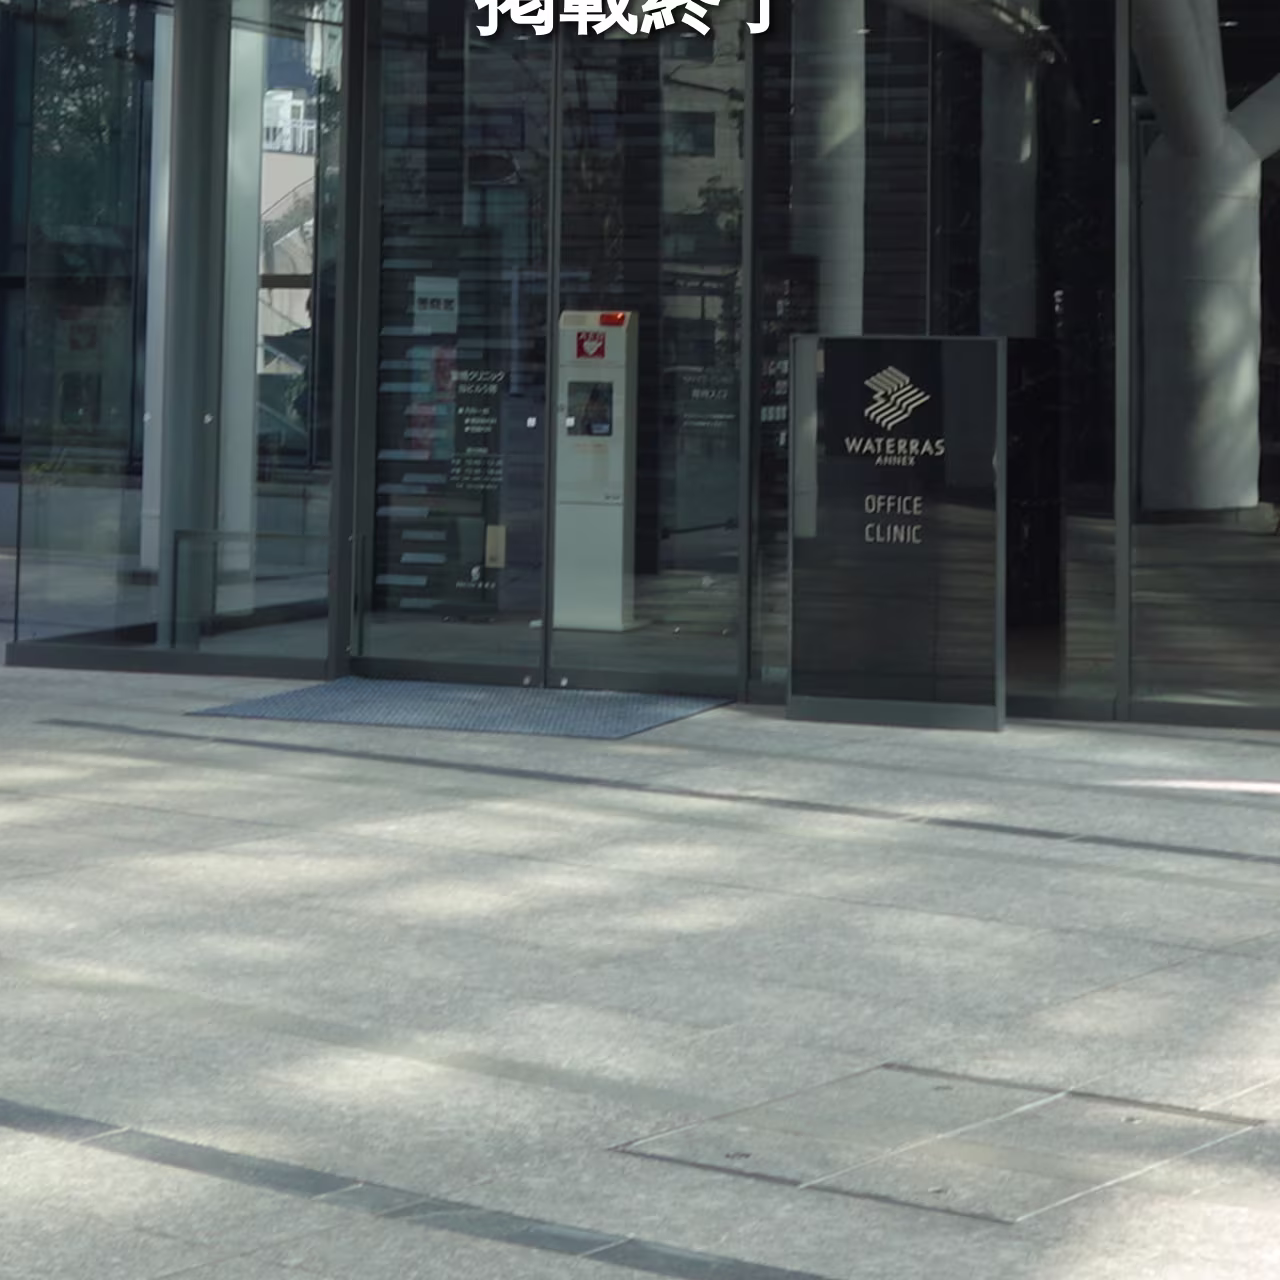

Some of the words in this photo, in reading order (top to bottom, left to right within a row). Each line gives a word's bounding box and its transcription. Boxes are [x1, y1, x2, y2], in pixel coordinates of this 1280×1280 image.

[844, 437, 945, 456] WATERRAS
[875, 455, 915, 466] ANNEX
[865, 495, 923, 515] OFFICE
[865, 523, 922, 543] CLINIC
